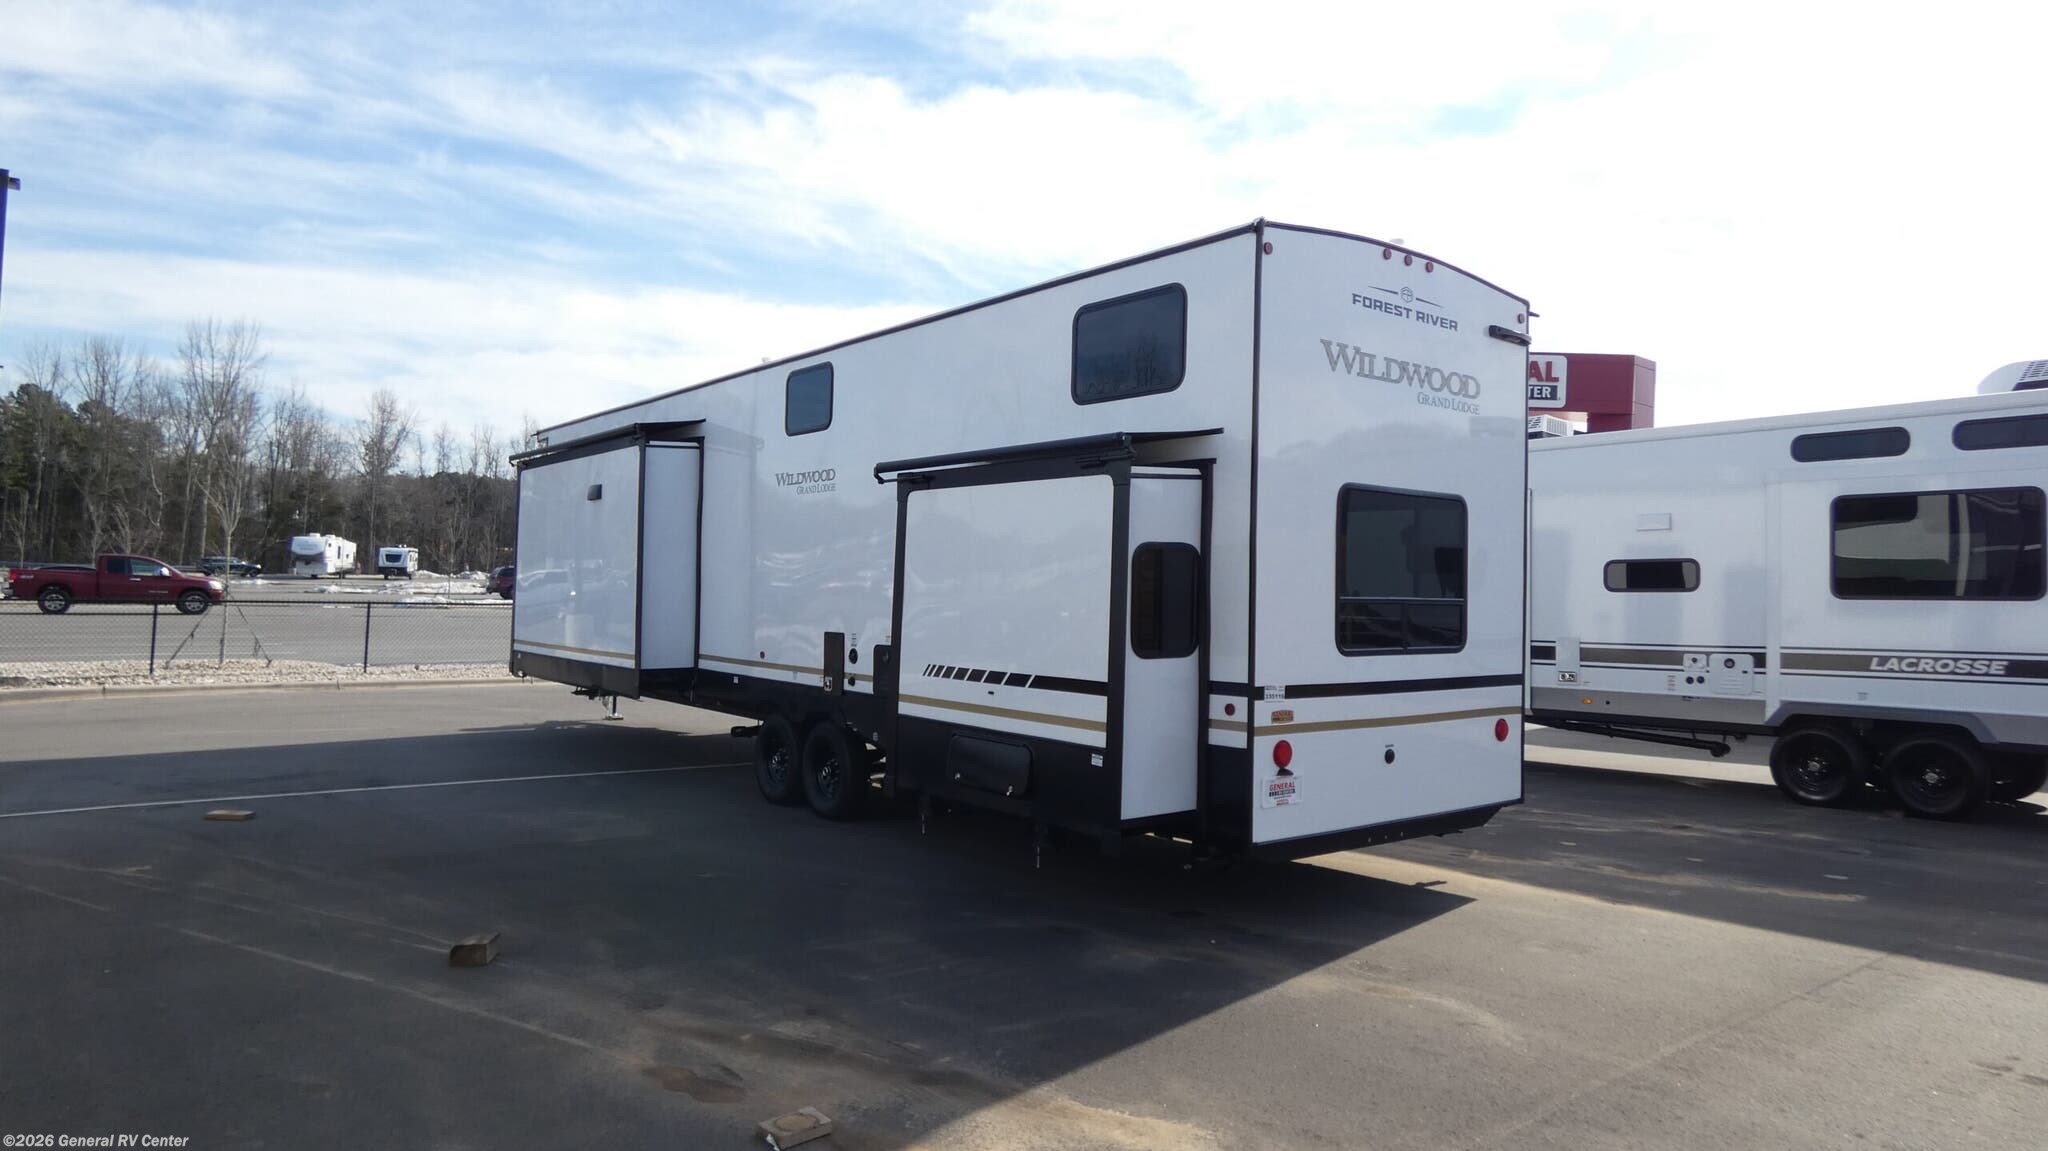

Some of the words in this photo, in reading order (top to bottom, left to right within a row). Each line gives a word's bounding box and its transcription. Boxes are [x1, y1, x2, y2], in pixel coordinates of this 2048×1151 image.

[1352, 293, 1412, 319] FOREST
[1416, 310, 1459, 332] RIVER
[1319, 339, 1480, 399] WILDWOOD
[775, 468, 836, 487] WILDWOOD
[1869, 657, 2009, 675] LACROSSE
